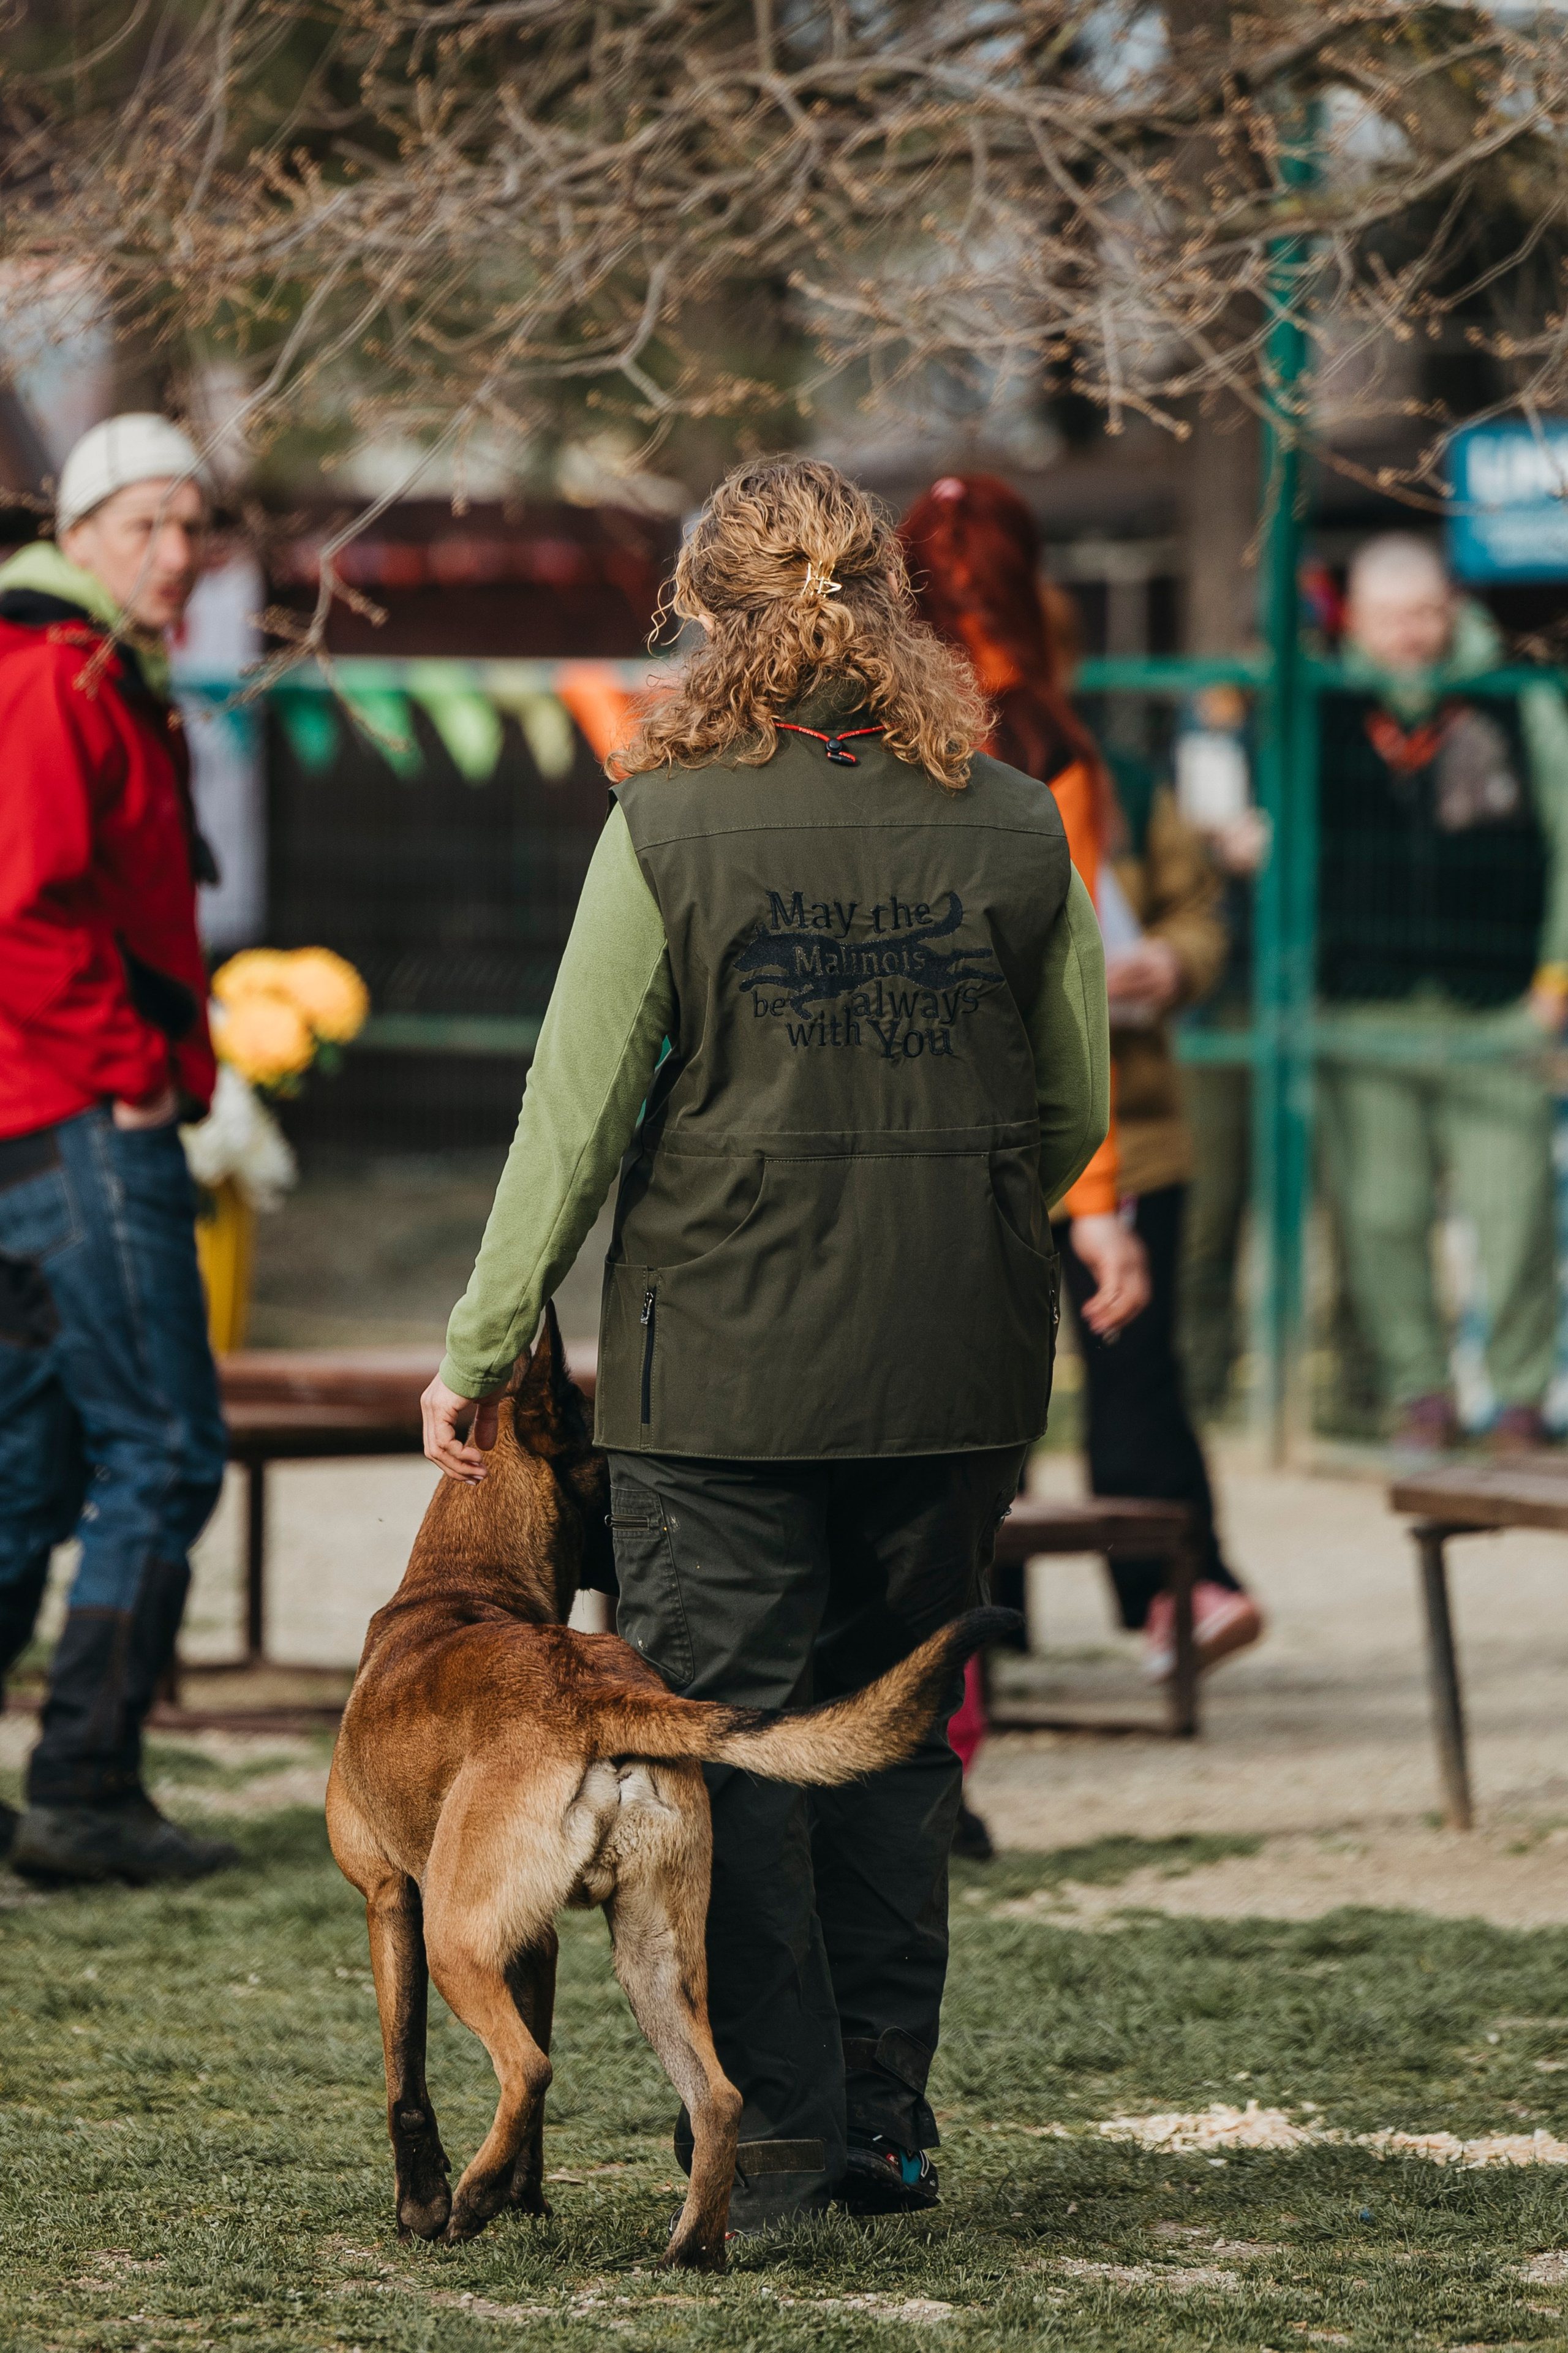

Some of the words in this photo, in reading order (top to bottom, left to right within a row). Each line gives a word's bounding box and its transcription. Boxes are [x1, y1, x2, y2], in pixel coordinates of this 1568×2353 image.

[766, 891, 858, 939] May
[870, 896, 933, 934] the
[796, 945, 925, 976] Malinois
[752, 991, 786, 1018] be
[852, 981, 979, 1024] always
[786, 1007, 861, 1047] with
[867, 1019, 953, 1059] You
